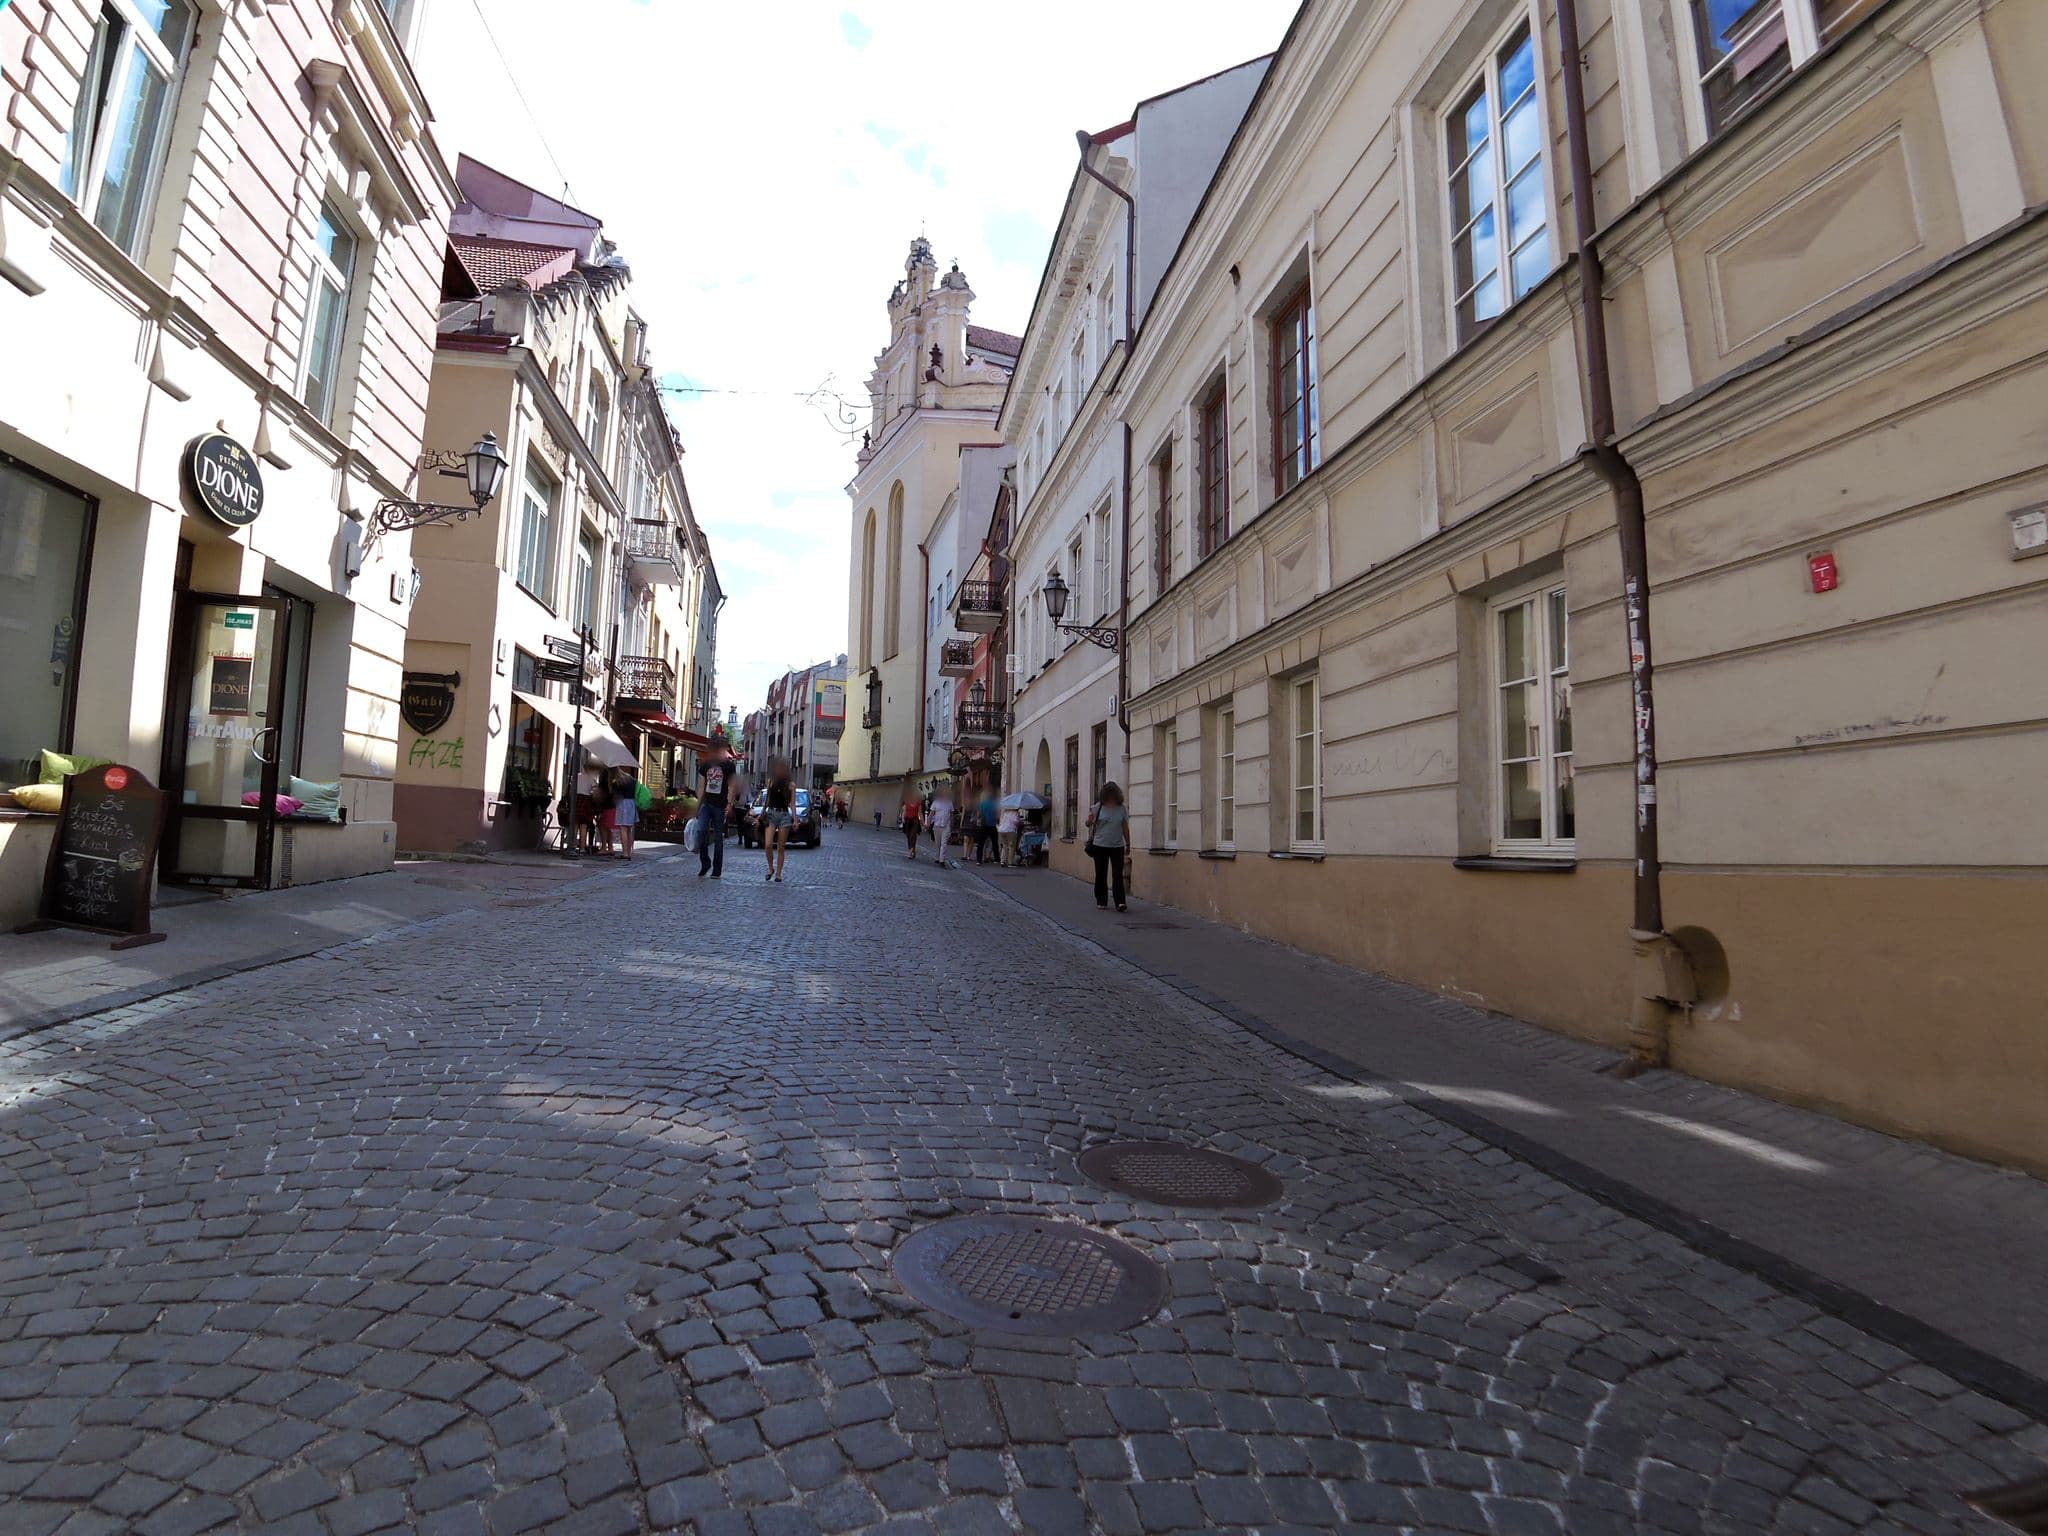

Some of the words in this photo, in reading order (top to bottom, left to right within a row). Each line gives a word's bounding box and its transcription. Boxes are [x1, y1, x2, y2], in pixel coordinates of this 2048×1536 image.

[219, 454, 249, 479] PREMIUM
[200, 455, 260, 514] DIONE
[212, 683, 249, 695] DIONE
